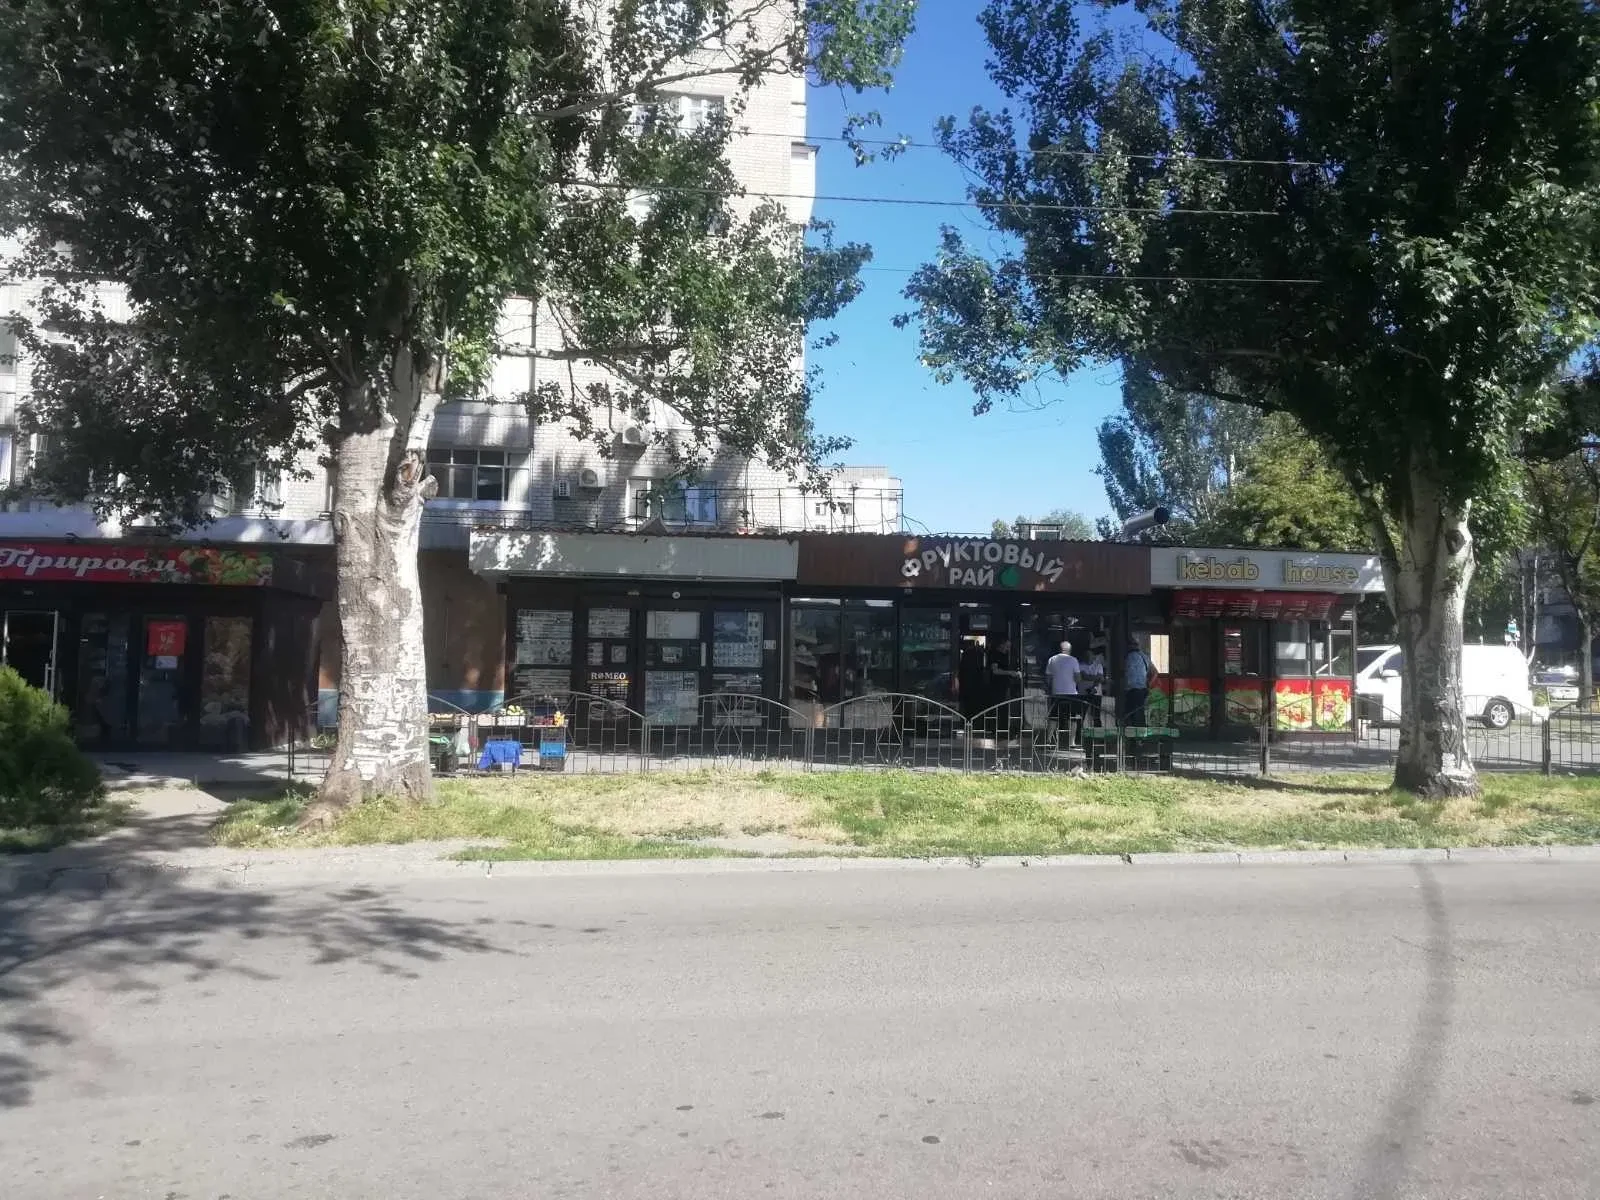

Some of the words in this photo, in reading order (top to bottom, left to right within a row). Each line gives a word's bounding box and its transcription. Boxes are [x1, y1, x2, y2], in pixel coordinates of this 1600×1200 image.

[901, 541, 1065, 583] ФРУКТОВЫЙ
[950, 565, 994, 587] РАЙ
[1177, 555, 1260, 581] kebab
[1282, 559, 1360, 583] house
